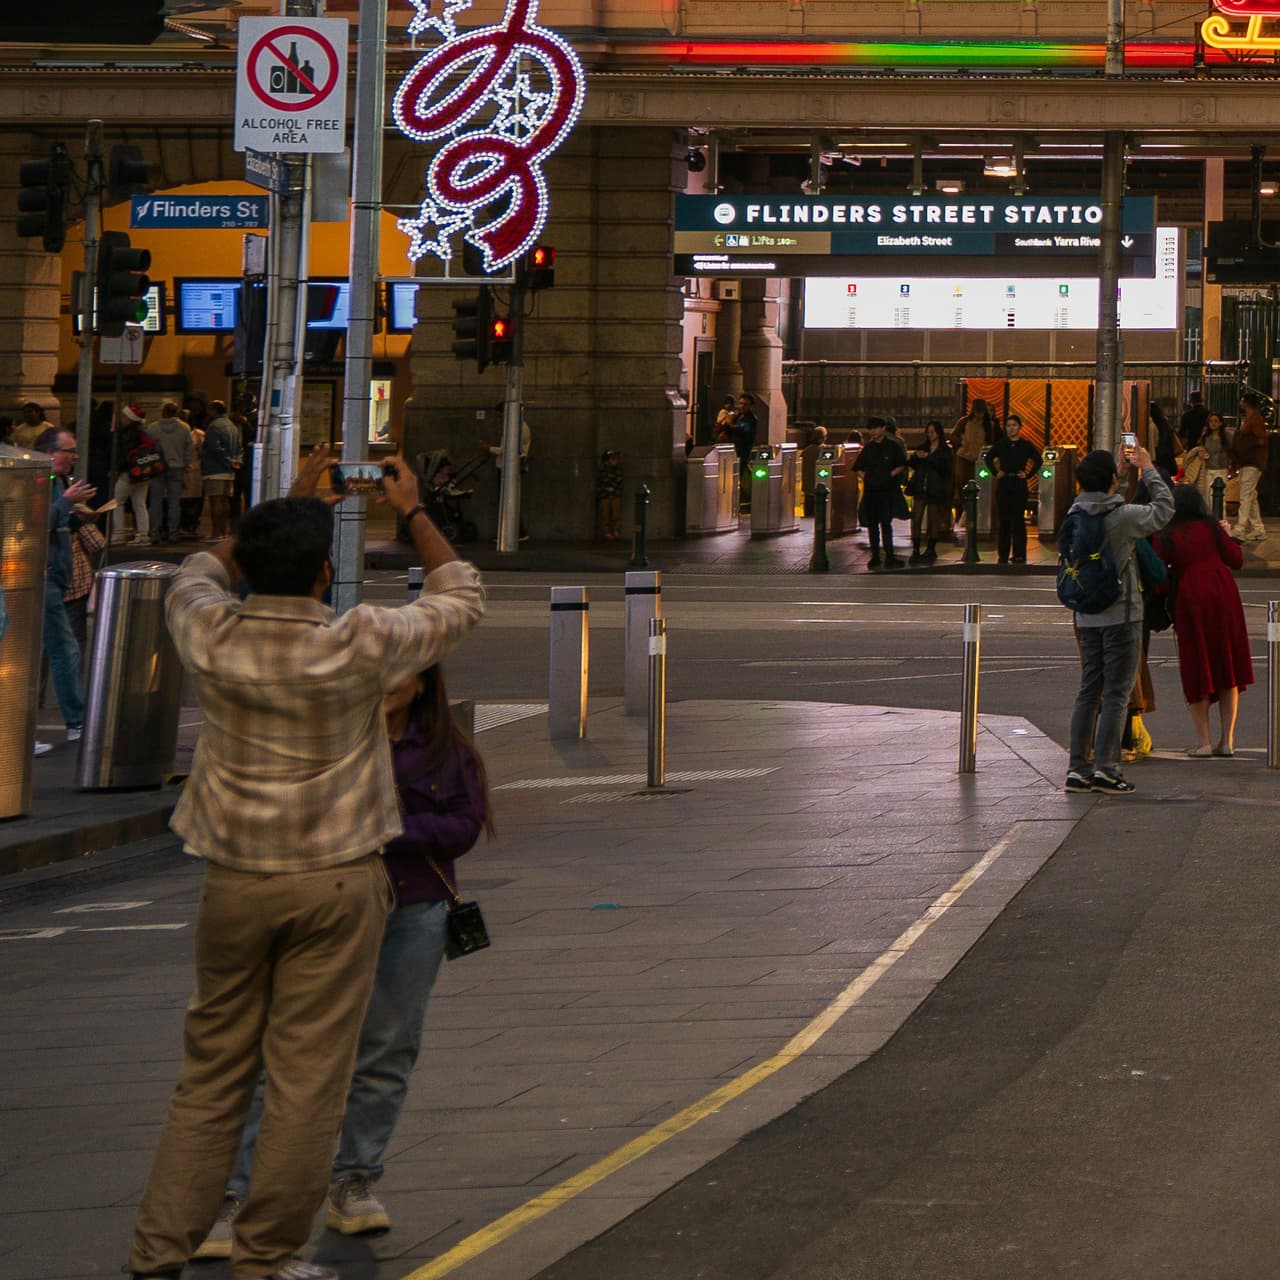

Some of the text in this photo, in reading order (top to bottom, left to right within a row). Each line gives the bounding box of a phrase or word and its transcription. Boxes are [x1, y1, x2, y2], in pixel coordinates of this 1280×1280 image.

[241, 118, 340, 130] ALCOHOL FREE
[272, 132, 308, 143] AREA
[152, 201, 259, 218] Flinders St
[746, 205, 1103, 223] FLINDERS STREET STATIO
[752, 235, 775, 246] Lifts
[877, 236, 953, 246] Elizabeth Street
[1054, 236, 1079, 247] Yarra
[1080, 236, 1101, 247] Rive
